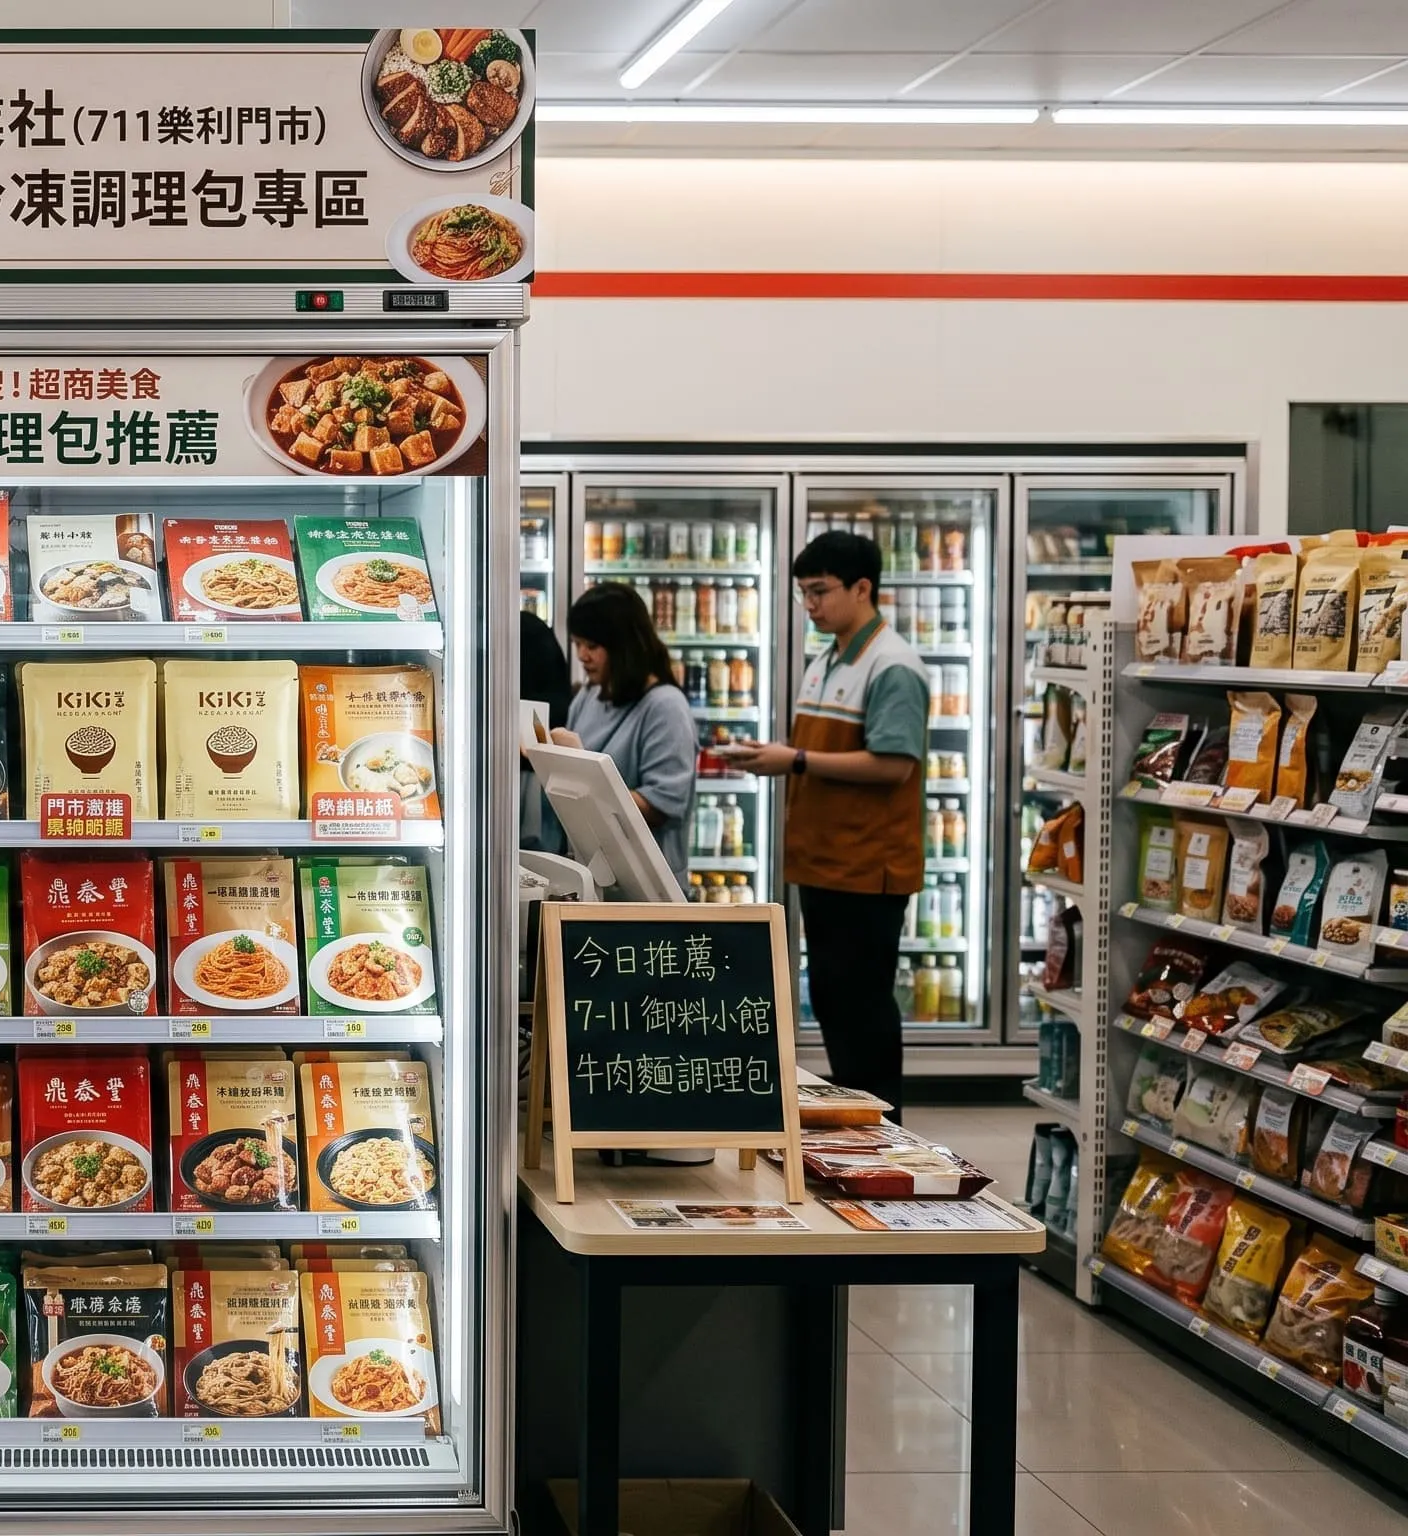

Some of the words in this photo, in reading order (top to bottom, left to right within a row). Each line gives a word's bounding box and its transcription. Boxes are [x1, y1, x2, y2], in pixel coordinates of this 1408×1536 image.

[573, 933, 731, 982] 今日推薦:
[574, 999, 630, 1032] 7-11
[640, 995, 772, 1036] 御料小館
[576, 1053, 775, 1096] 牛肉麵調理包
